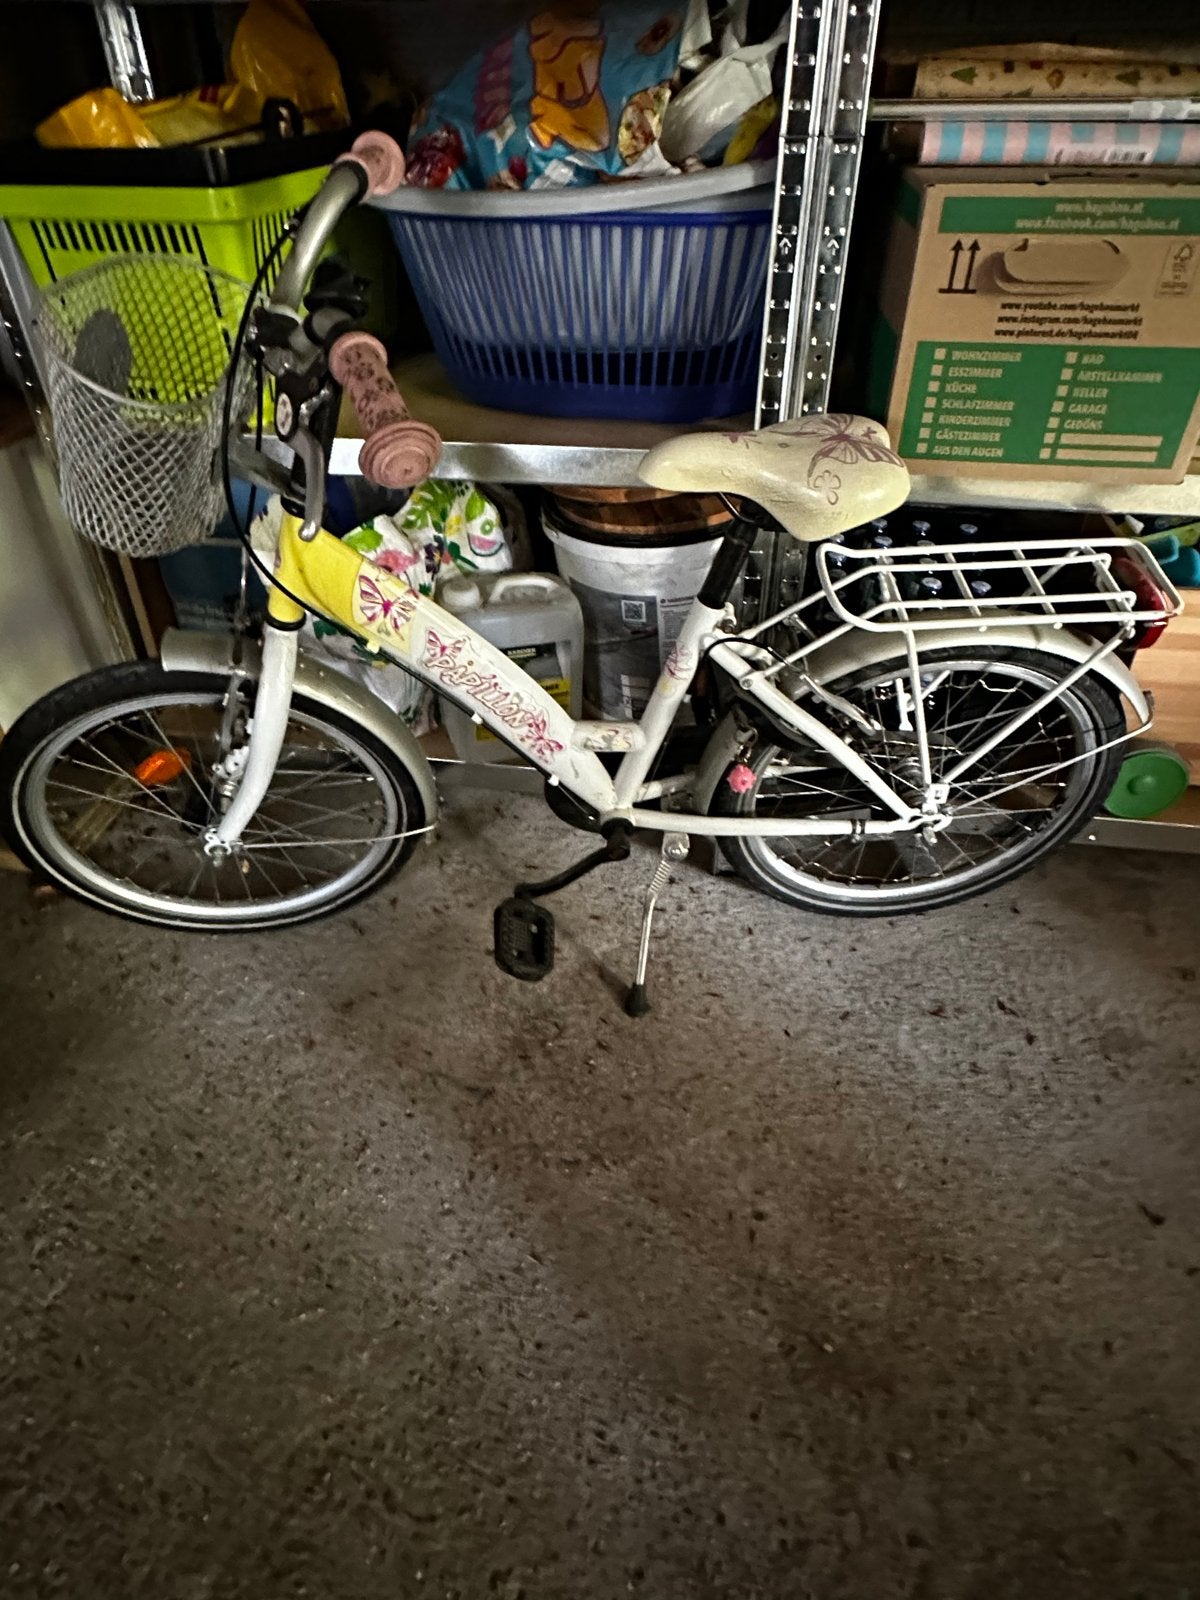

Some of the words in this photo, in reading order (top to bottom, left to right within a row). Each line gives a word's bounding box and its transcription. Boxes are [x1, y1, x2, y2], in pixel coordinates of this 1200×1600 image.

[951, 350, 1022, 362] WOHNZIMMER
[948, 366, 1003, 378] ESSZIMMER
[945, 382, 977, 394] KÜCHE
[942, 399, 1015, 411] SCHLAFZIMMER
[1068, 403, 1107, 415] GARAGE
[936, 429, 1001, 442] GÄSTEZIMMER
